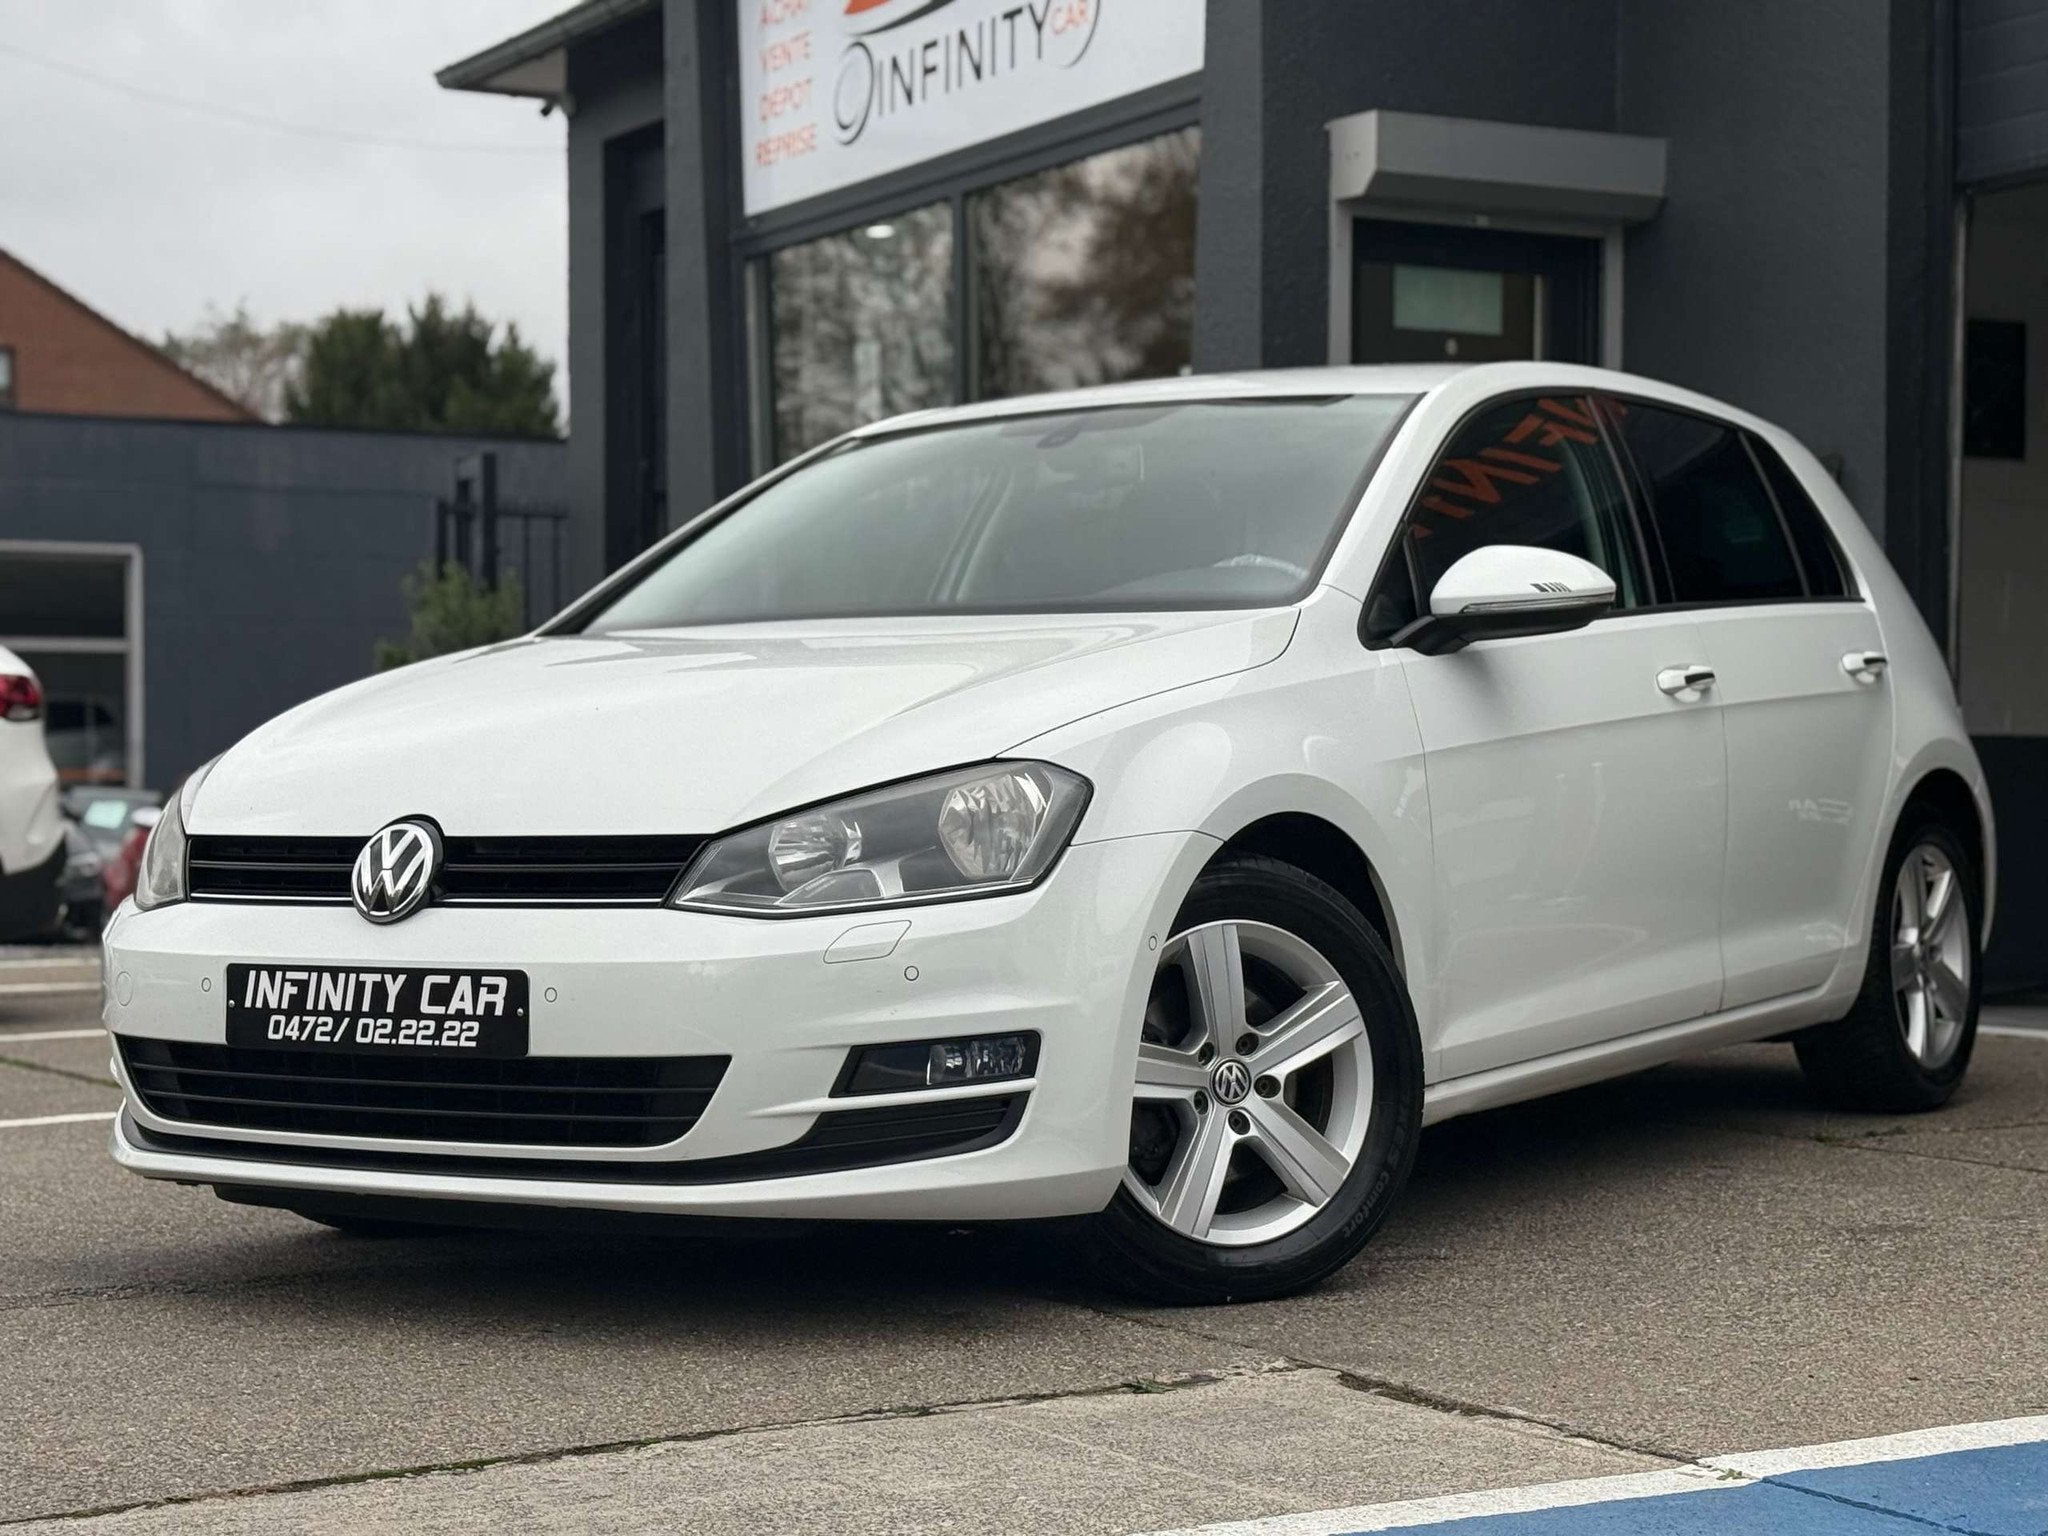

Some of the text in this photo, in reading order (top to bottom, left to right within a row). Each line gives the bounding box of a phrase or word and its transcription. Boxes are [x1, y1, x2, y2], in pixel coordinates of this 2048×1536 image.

[877, 0, 1050, 117] INFINITY
[244, 969, 508, 1017] INFINITY CAR
[267, 1014, 480, 1047] 0472/ 02.22.22
